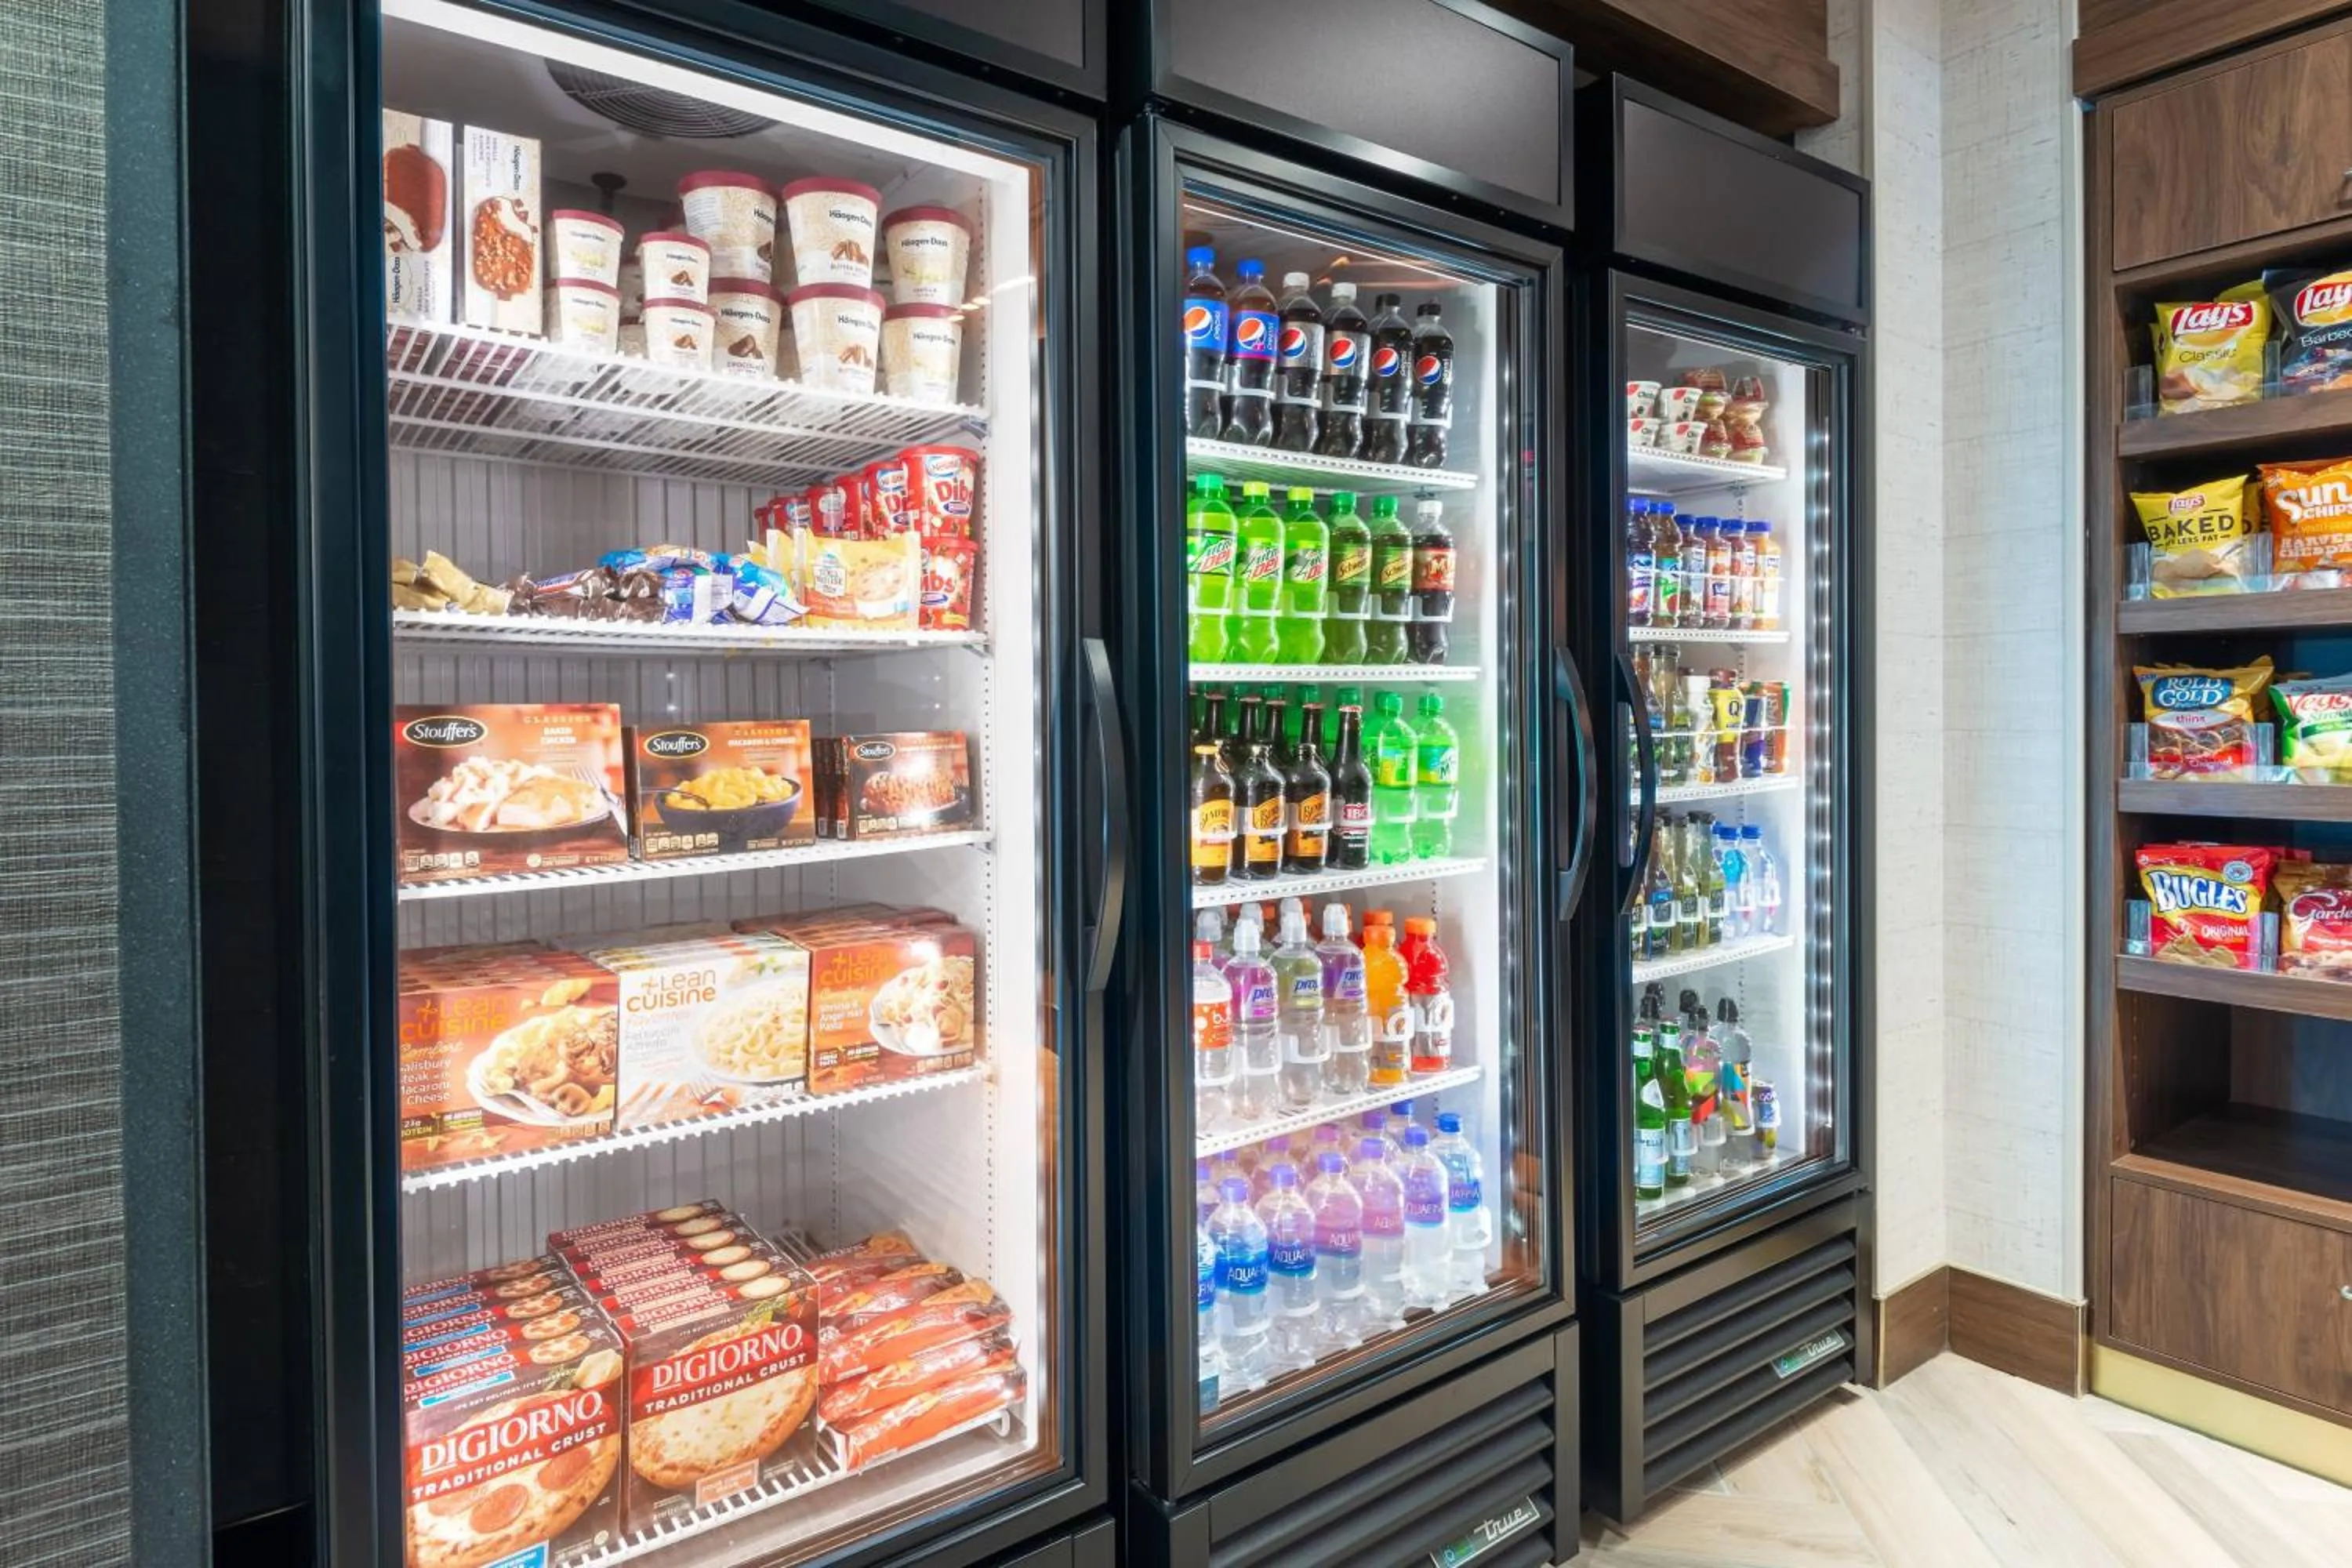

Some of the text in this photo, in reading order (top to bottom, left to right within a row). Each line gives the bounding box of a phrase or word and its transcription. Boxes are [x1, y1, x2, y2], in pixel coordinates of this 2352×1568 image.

[2300, 285, 2352, 317] Lay
[2175, 302, 2247, 336] Lay's
[2147, 514, 2234, 541] BAKED
[920, 570, 954, 591] ibs
[2167, 677, 2222, 690] ROLD
[2158, 689, 2223, 706] GOLD
[414, 722, 478, 741] Stouffer's
[652, 736, 701, 753] Stouffer's
[2148, 869, 2248, 915] BUGLES
[2201, 924, 2250, 938] ORIGINAL
[660, 969, 716, 991] Lean
[440, 996, 506, 1018] Lean
[401, 1058, 452, 1072] alisbury
[401, 1071, 428, 1083] teak
[652, 1323, 804, 1394] DIGIORNO
[644, 1352, 815, 1414] TRADITIONAL CRUST
[421, 1391, 604, 1477] DIGIORNO
[412, 1422, 607, 1500] TRADITIONAL CRUST
[1474, 1507, 1531, 1541] true
